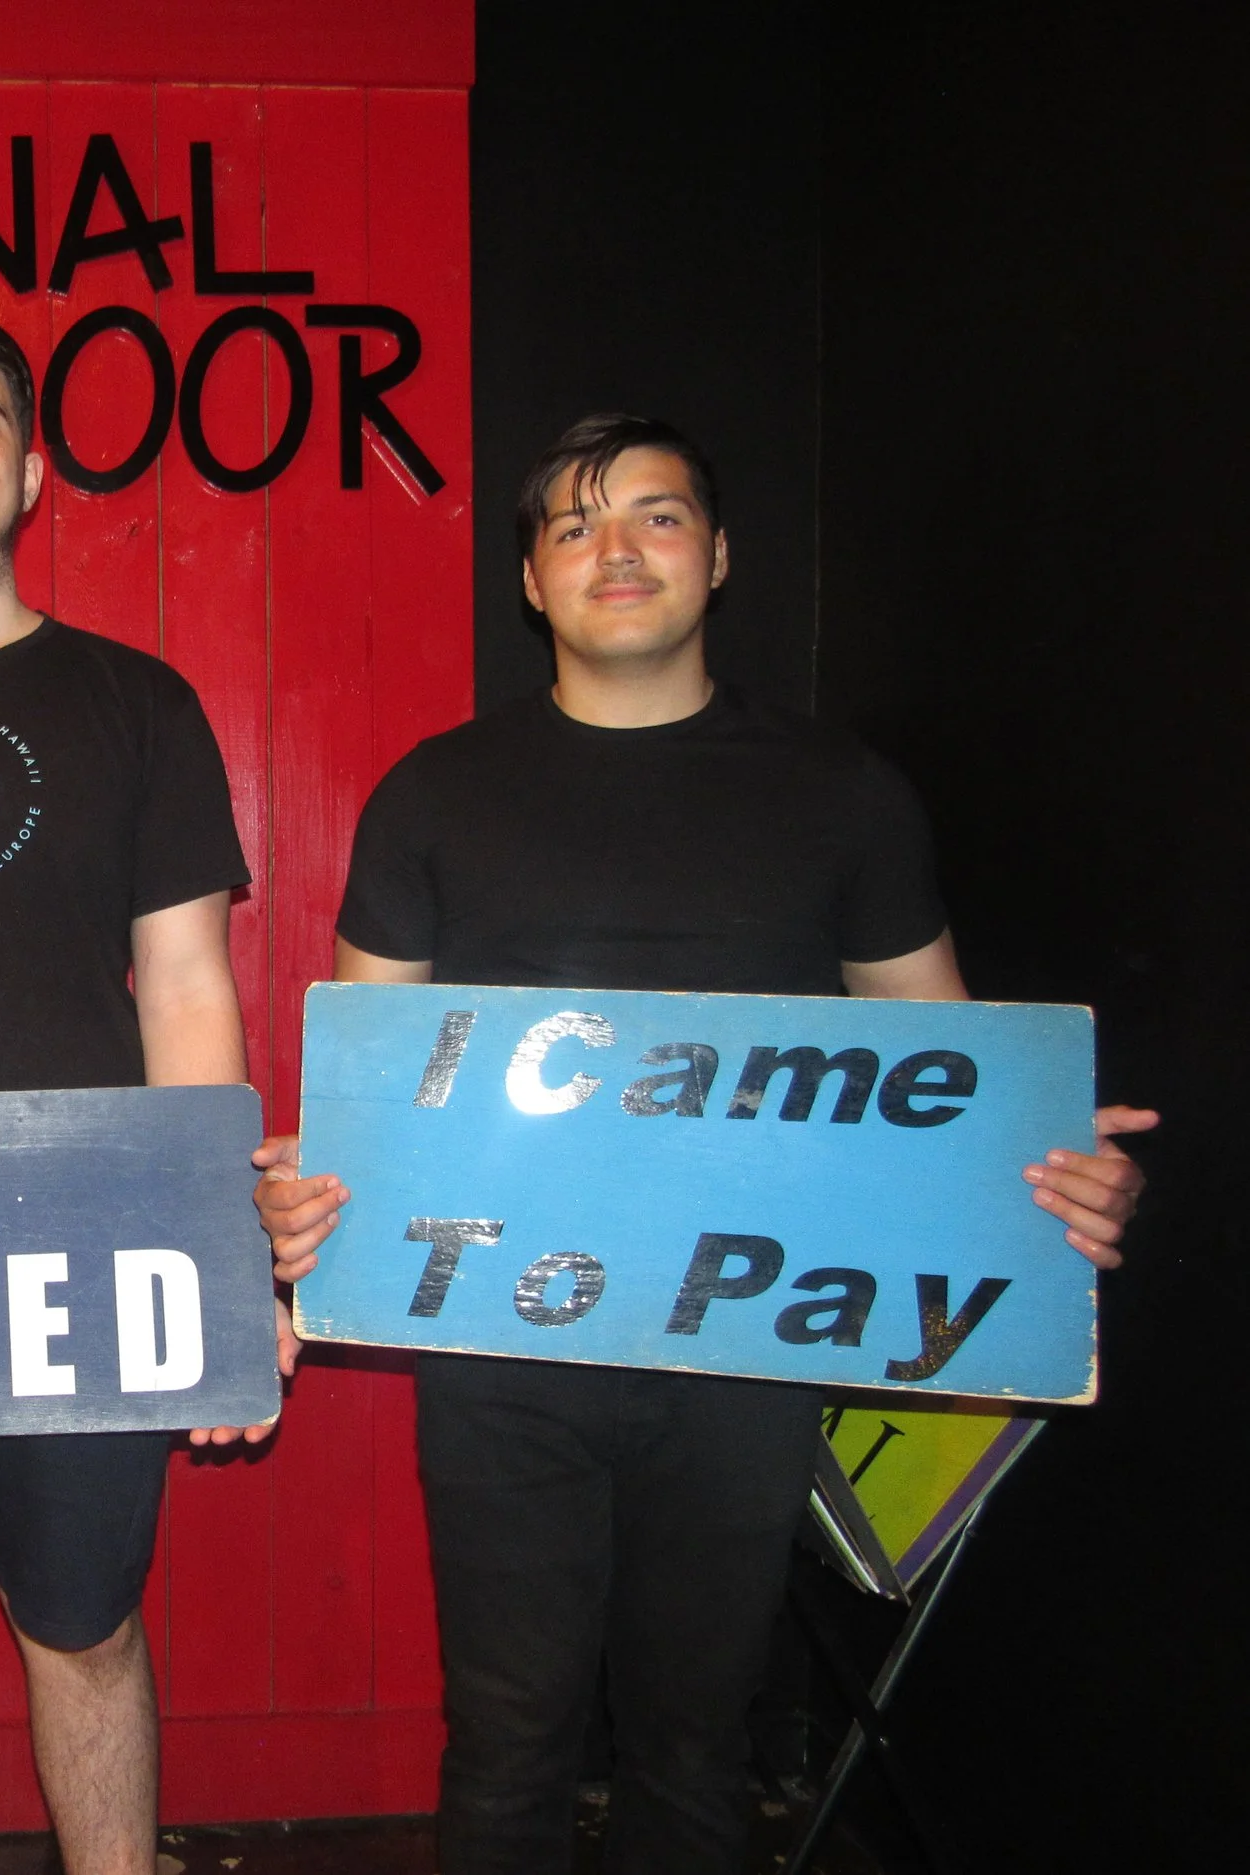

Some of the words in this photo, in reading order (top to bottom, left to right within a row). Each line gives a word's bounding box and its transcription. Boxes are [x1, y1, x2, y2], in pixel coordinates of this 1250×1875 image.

[41, 304, 446, 497] OOR
[413, 1010, 477, 1108] I
[505, 1010, 978, 1128] Came
[404, 1217, 607, 1328] To
[664, 1232, 1013, 1382] Pay
